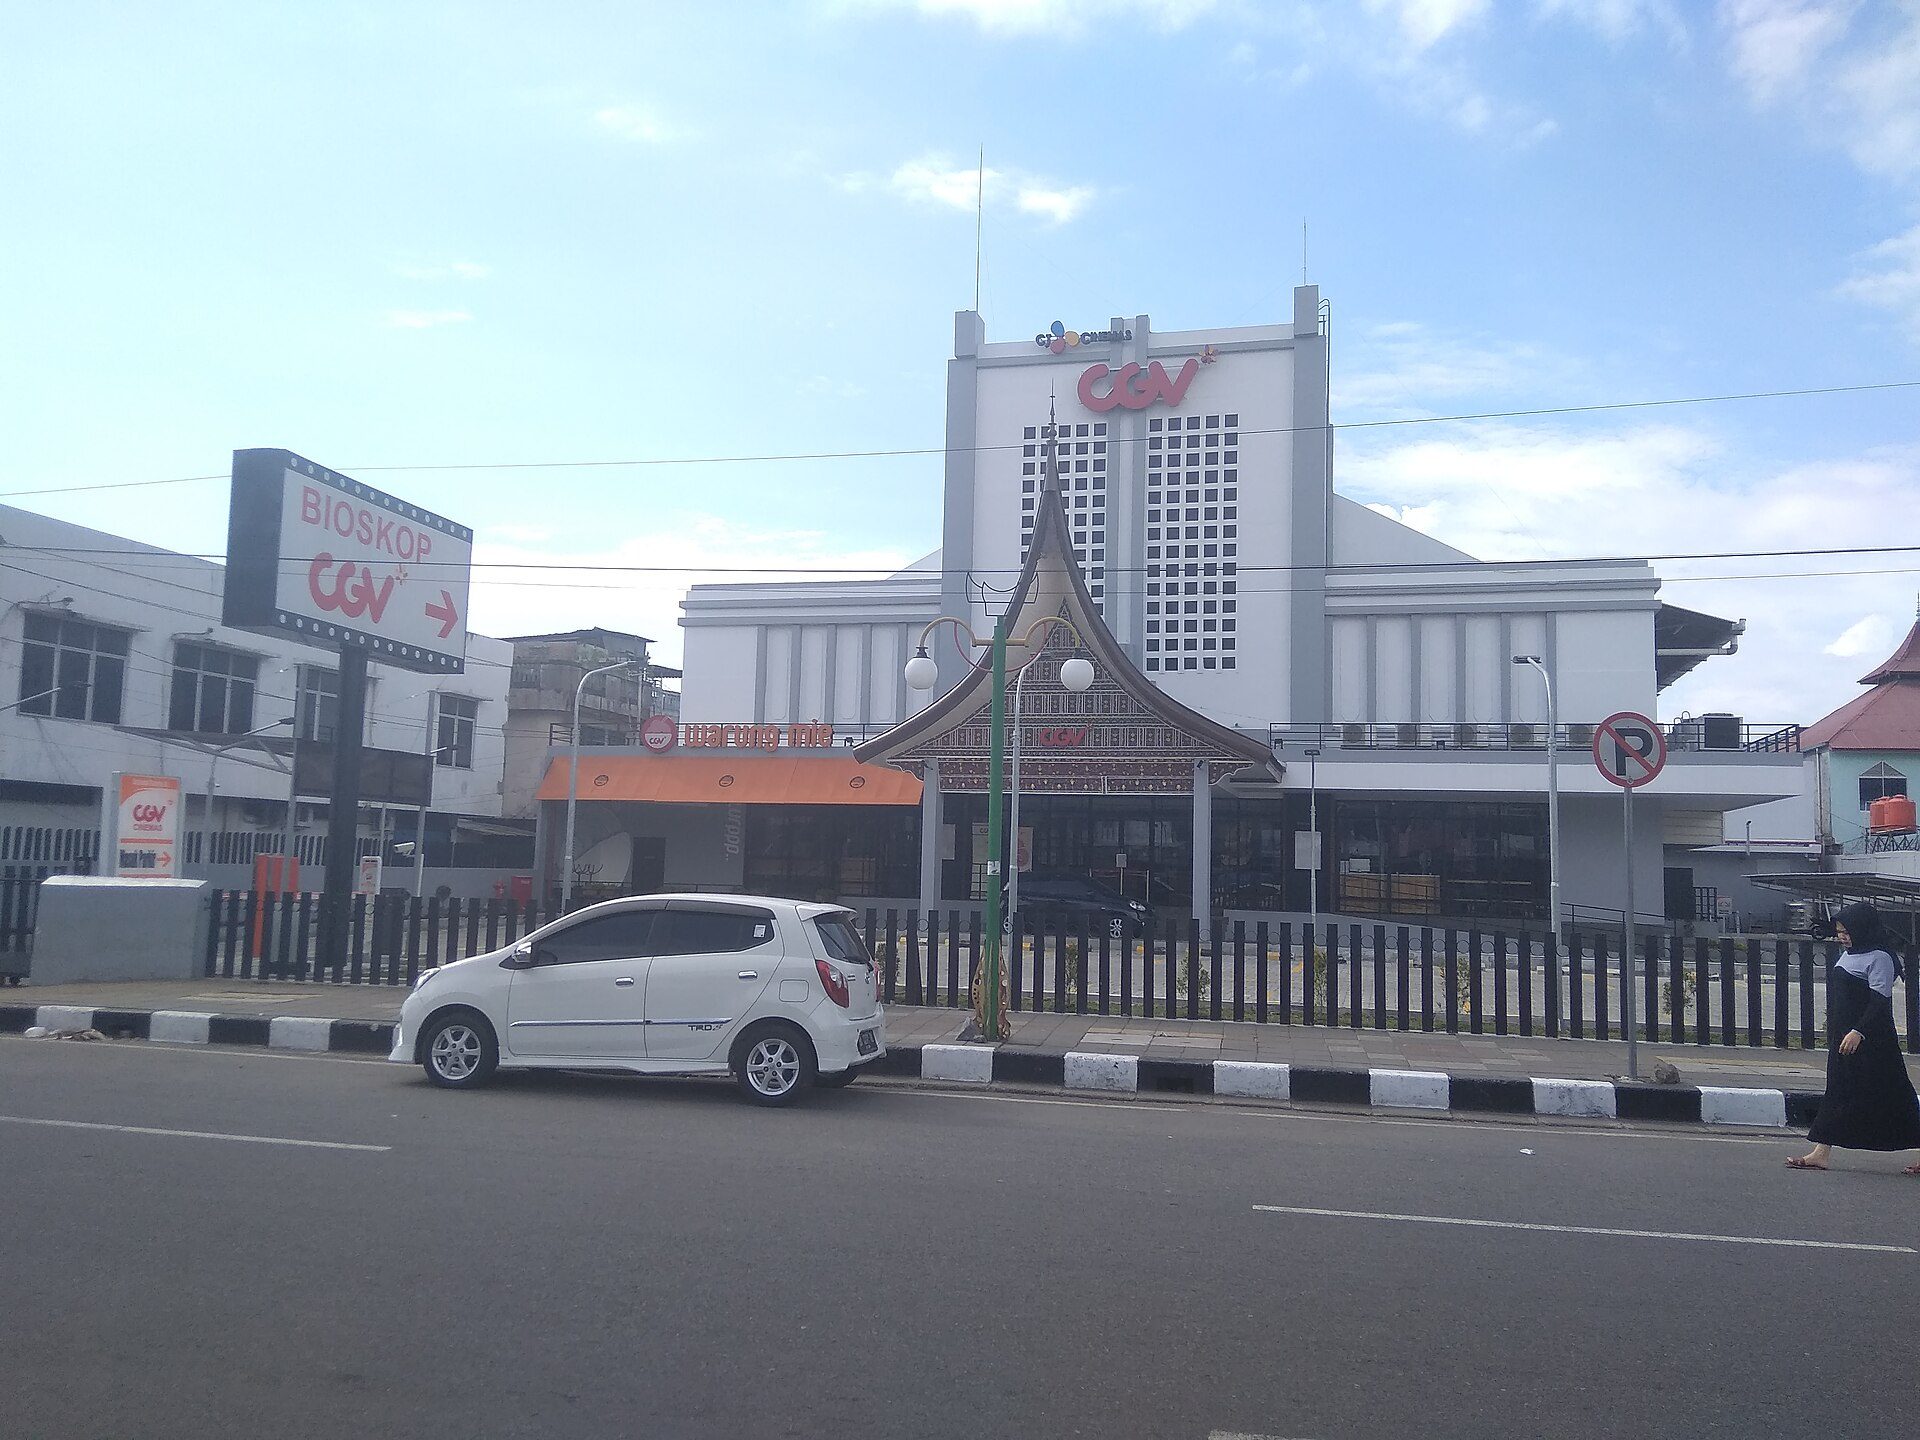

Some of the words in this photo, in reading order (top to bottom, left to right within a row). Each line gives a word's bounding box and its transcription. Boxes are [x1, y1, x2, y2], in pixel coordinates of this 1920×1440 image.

[1036, 334, 1051, 348] CJ
[1077, 358, 1199, 412] CGV
[301, 486, 432, 563] BIOSKOP
[309, 552, 394, 624] CGV
[649, 737, 665, 745] CGV
[685, 724, 780, 752] warung
[788, 719, 834, 748] mie
[1040, 727, 1086, 747] CGV
[1615, 727, 1653, 776] P
[133, 804, 167, 822] CGV
